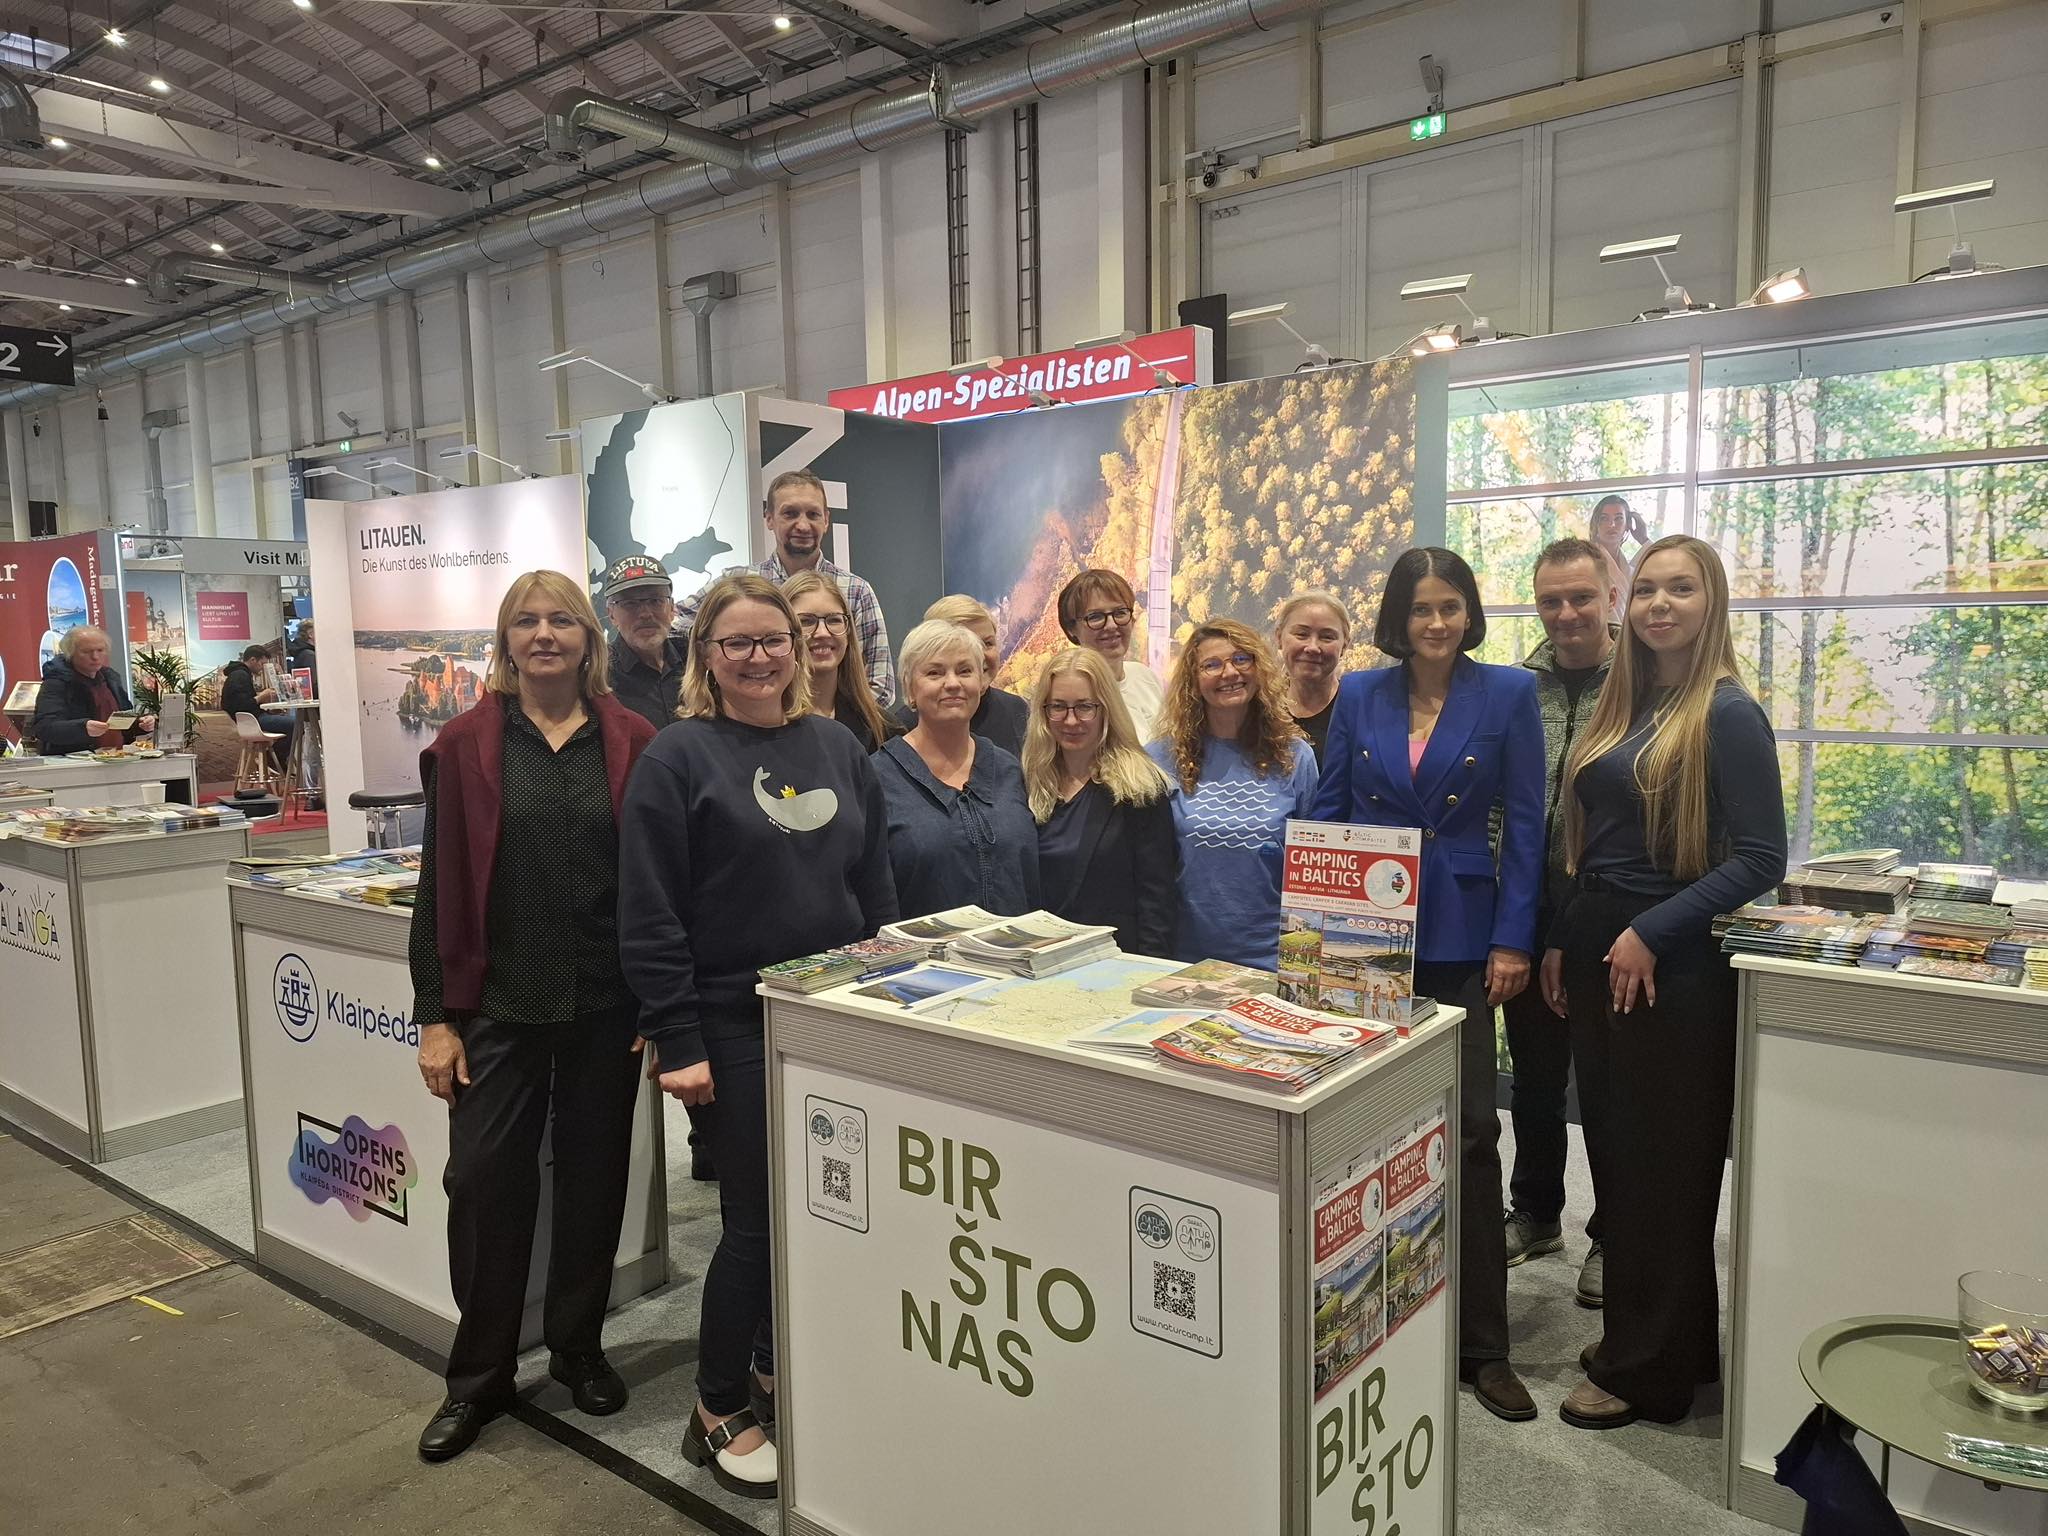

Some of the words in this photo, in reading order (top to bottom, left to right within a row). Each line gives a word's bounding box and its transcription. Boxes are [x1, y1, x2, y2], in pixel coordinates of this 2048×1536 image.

[873, 355, 1132, 419] Alpen-Spezialisten
[360, 524, 426, 550] LITAUEN.
[244, 551, 281, 565] Visit
[362, 558, 378, 573] Die
[379, 556, 407, 573] Kunst
[409, 555, 427, 570] des
[429, 550, 512, 568] Wohlbefindens.
[610, 556, 660, 579] LIETUVA
[87, 546, 101, 629] Madagaska
[1289, 871, 1300, 881] IN
[1302, 867, 1361, 888] BALTICS
[1290, 850, 1358, 870] CAMPING
[327, 989, 419, 1048] Klaipėda
[1248, 1000, 1317, 1026] CAMPING
[1250, 1009, 1313, 1031] BALTICS
[343, 1129, 406, 1177] OPENS
[1389, 1143, 1423, 1178] CAMPING
[305, 1142, 398, 1204] HORIZONS
[899, 1125, 1001, 1221] BIR
[1390, 1184, 1397, 1196] IN
[1397, 1158, 1426, 1191] BALTICS
[332, 1184, 360, 1205] DISTRICT
[1319, 1189, 1358, 1229] CAMPING
[1319, 1235, 1327, 1248] IN
[1327, 1206, 1361, 1243] BALTICS
[949, 1212, 1096, 1343] ŠTO
[902, 1289, 1034, 1398] NAS
[1137, 1312, 1215, 1346] www.naturcamp.lt
[1317, 1367, 1386, 1497] BIR
